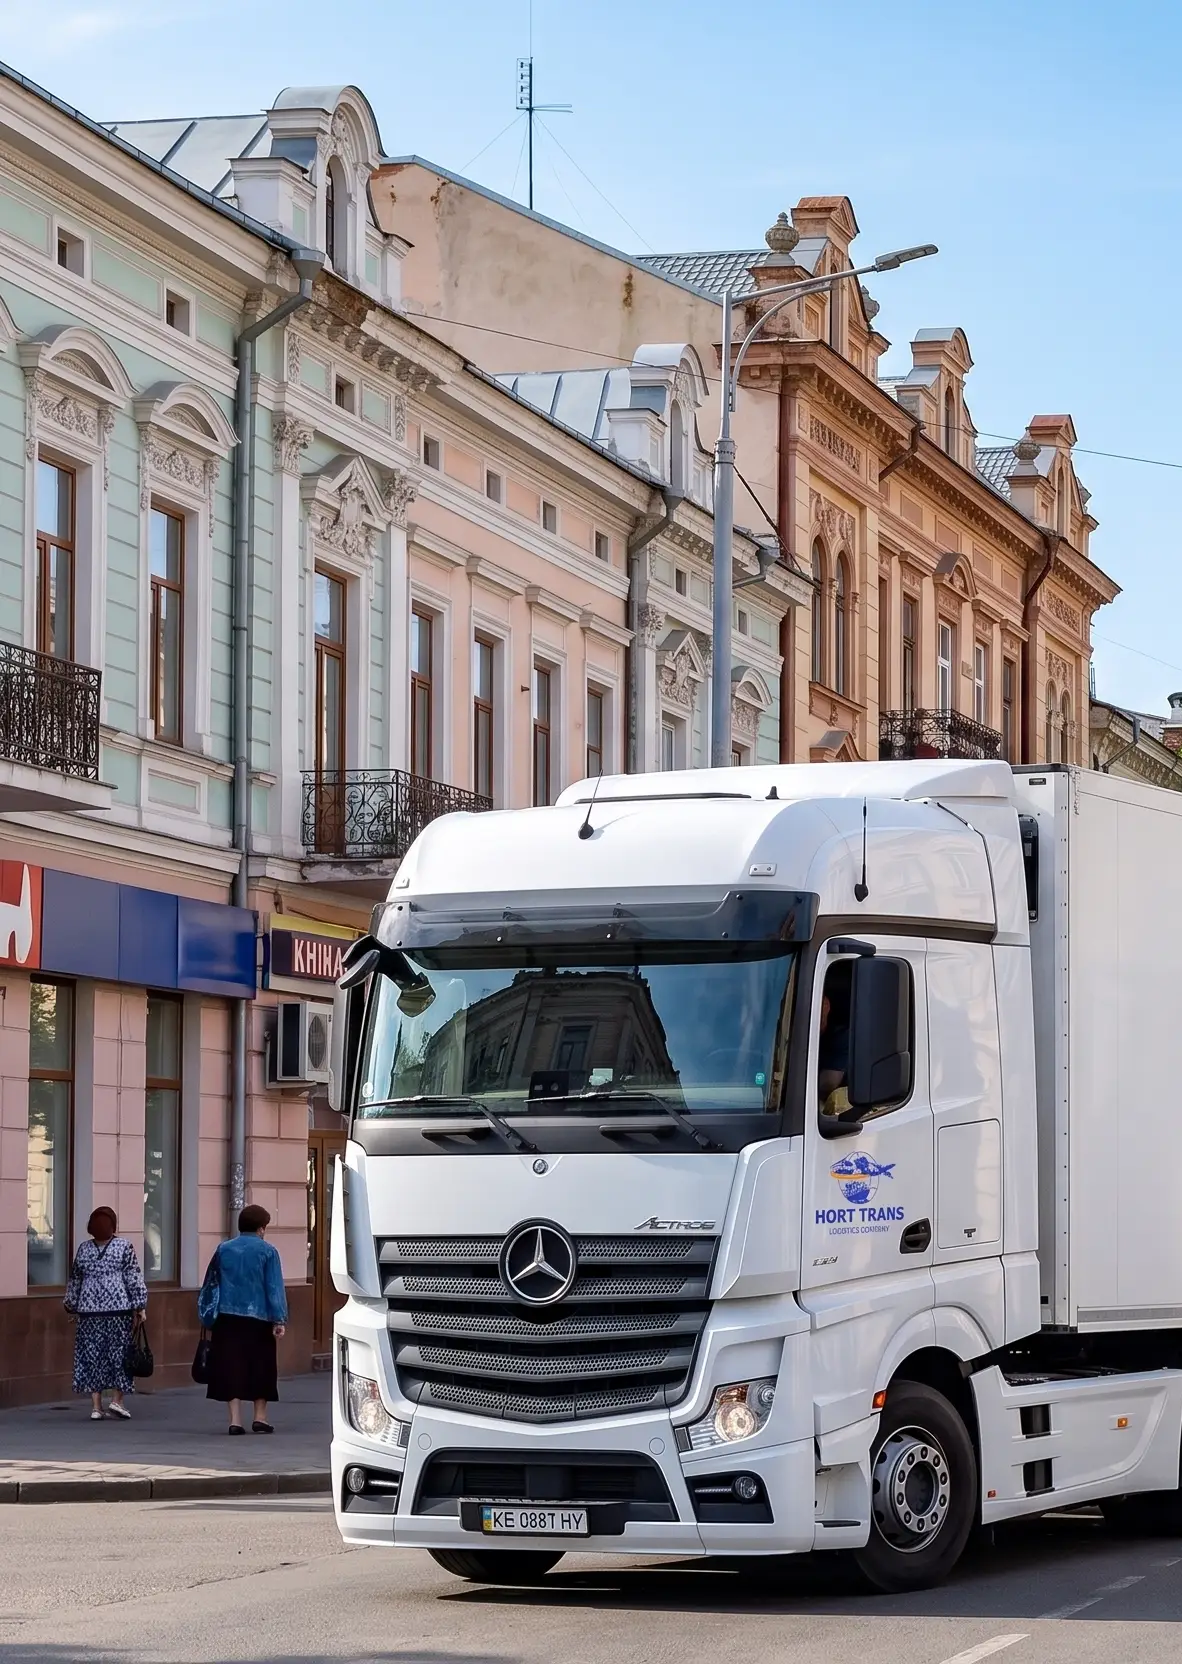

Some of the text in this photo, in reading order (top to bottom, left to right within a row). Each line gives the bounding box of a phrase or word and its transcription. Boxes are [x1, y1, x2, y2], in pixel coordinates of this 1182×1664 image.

[815, 1206, 905, 1225] HORT TRANS
[493, 1511, 515, 1528] KE
[560, 1513, 584, 1530] HY
